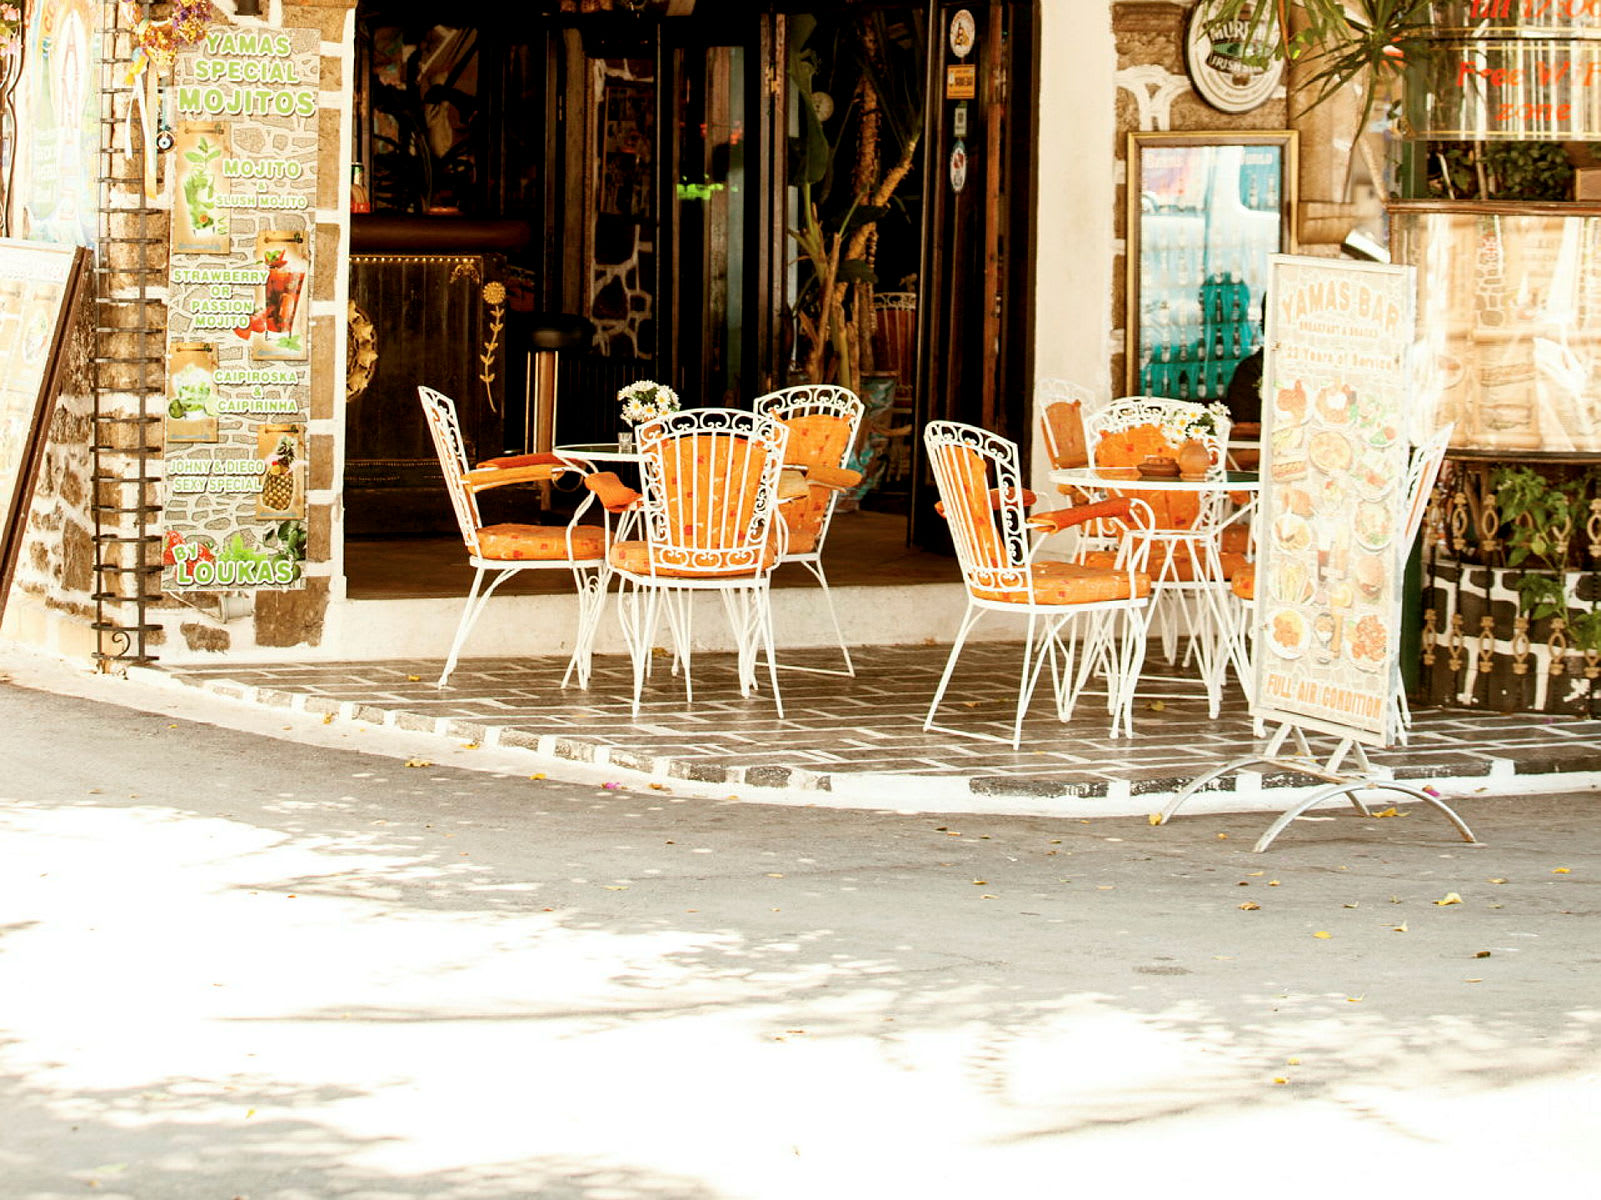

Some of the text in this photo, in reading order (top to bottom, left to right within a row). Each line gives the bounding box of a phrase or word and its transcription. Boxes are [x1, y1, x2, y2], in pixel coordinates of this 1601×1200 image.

[205, 34, 291, 56] YAMAS
[194, 60, 300, 84] SPECIAL
[1456, 61, 1523, 87] Free
[178, 87, 316, 117] MOJITOS
[1495, 102, 1572, 121] zone
[223, 159, 302, 179] MOJITO
[256, 181, 267, 193] &
[215, 195, 308, 209] SLUSH MOJITO
[174, 269, 269, 282] STRAWBERRY
[211, 285, 231, 297] OR
[191, 301, 253, 313] PASSION
[1281, 279, 1400, 334] YAMAS BAR
[194, 315, 250, 327] MOJITO
[213, 370, 298, 384] CAIPIROSKA
[252, 386, 263, 397] &
[217, 400, 298, 413] CAIPIRINHA
[169, 460, 265, 474] JOHNY & DIEGO
[174, 477, 262, 492] SEXY SPECIAL
[176, 560, 294, 586] LOUKAS
[1265, 673, 1383, 720] FULL AIR CONDITION
